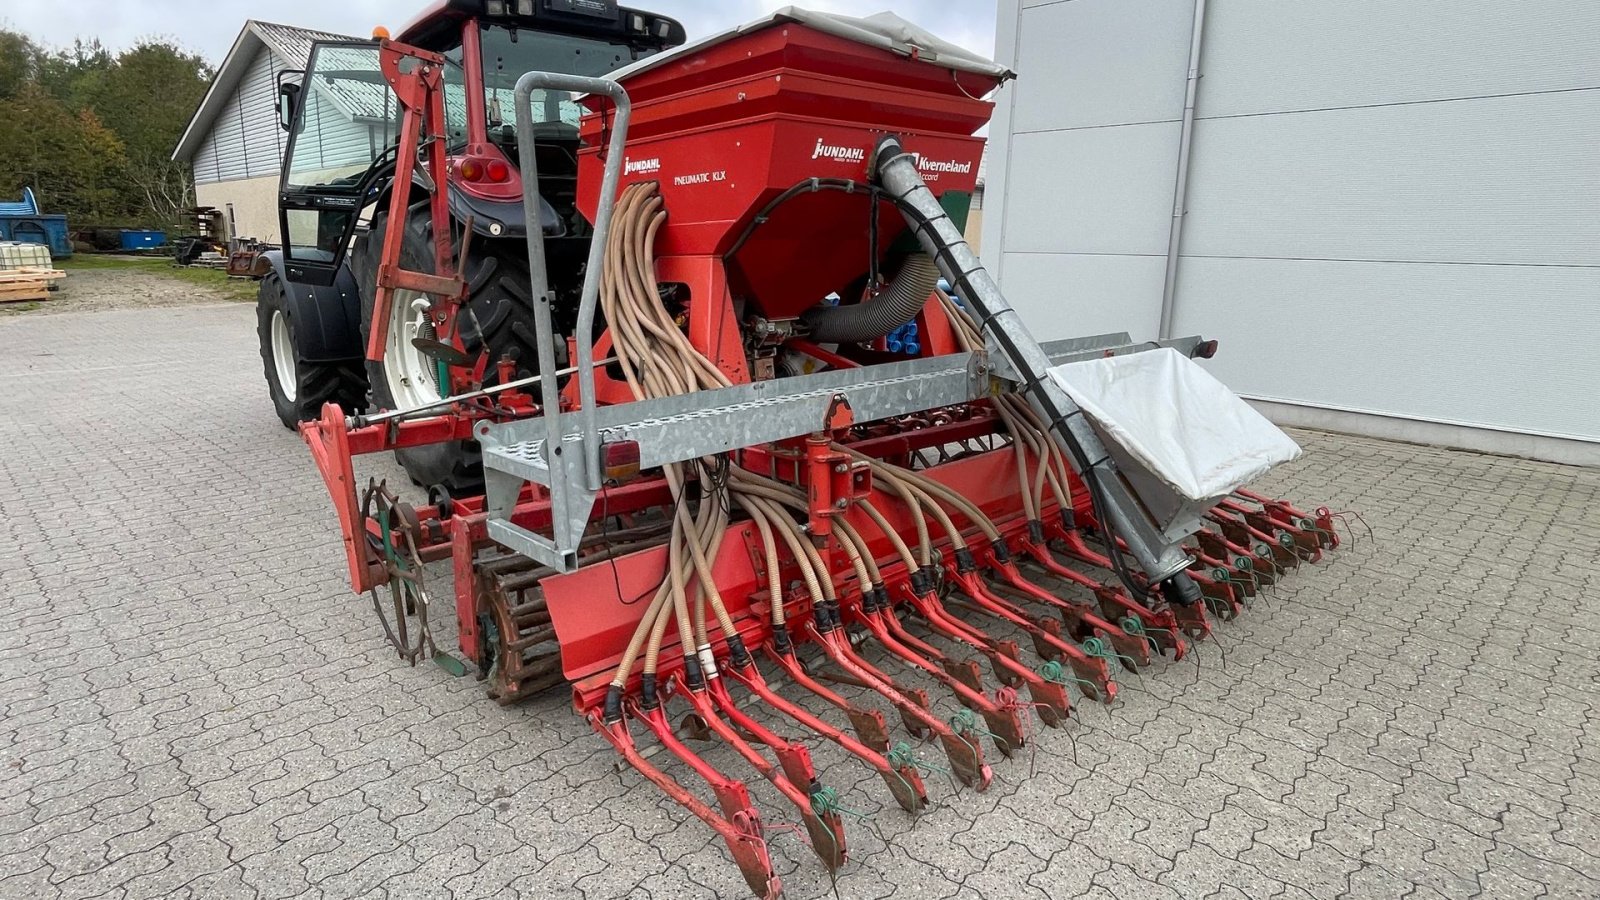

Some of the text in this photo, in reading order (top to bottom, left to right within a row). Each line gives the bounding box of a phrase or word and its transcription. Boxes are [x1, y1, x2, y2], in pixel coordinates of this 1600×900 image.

[919, 157, 971, 173] Kverneland
[674, 171, 726, 185] PNEUMATIC KLX
